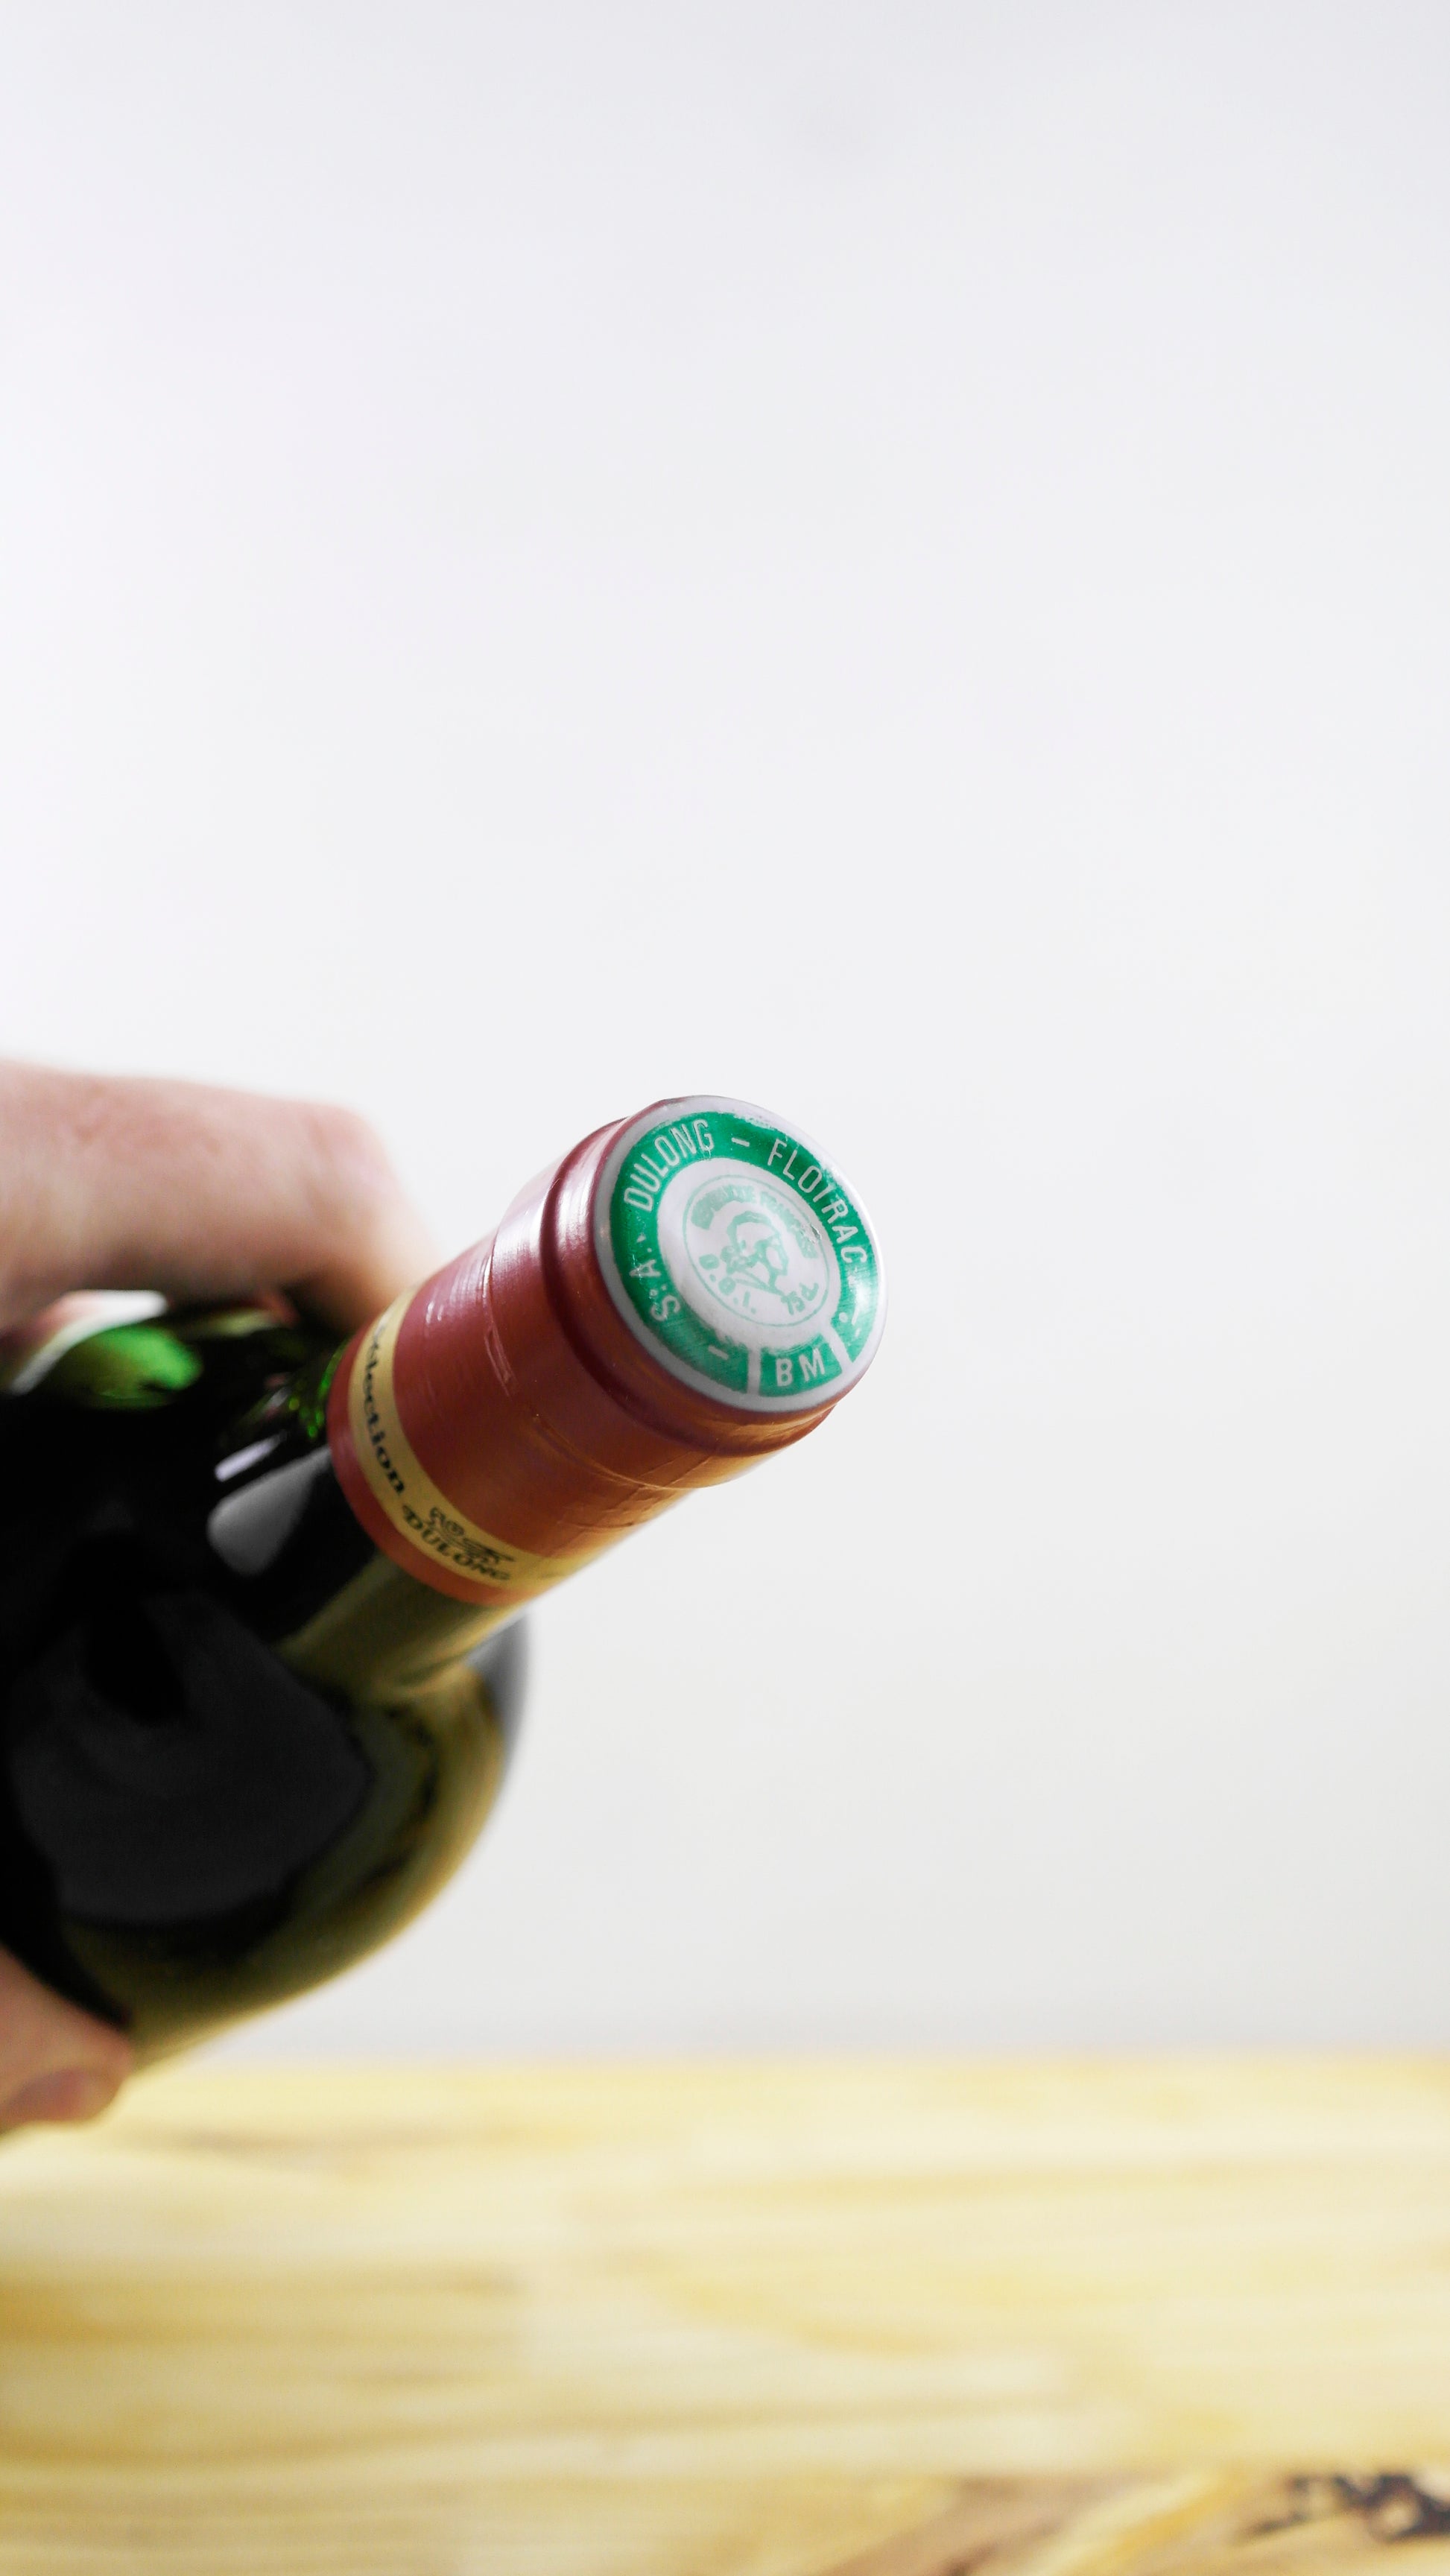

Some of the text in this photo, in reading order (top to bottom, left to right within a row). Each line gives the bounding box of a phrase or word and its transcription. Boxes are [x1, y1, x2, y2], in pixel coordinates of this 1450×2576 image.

[624, 1119, 715, 1212] DULONG
[776, 1347, 826, 1387] BM
[402, 1504, 511, 1580] DULONG
